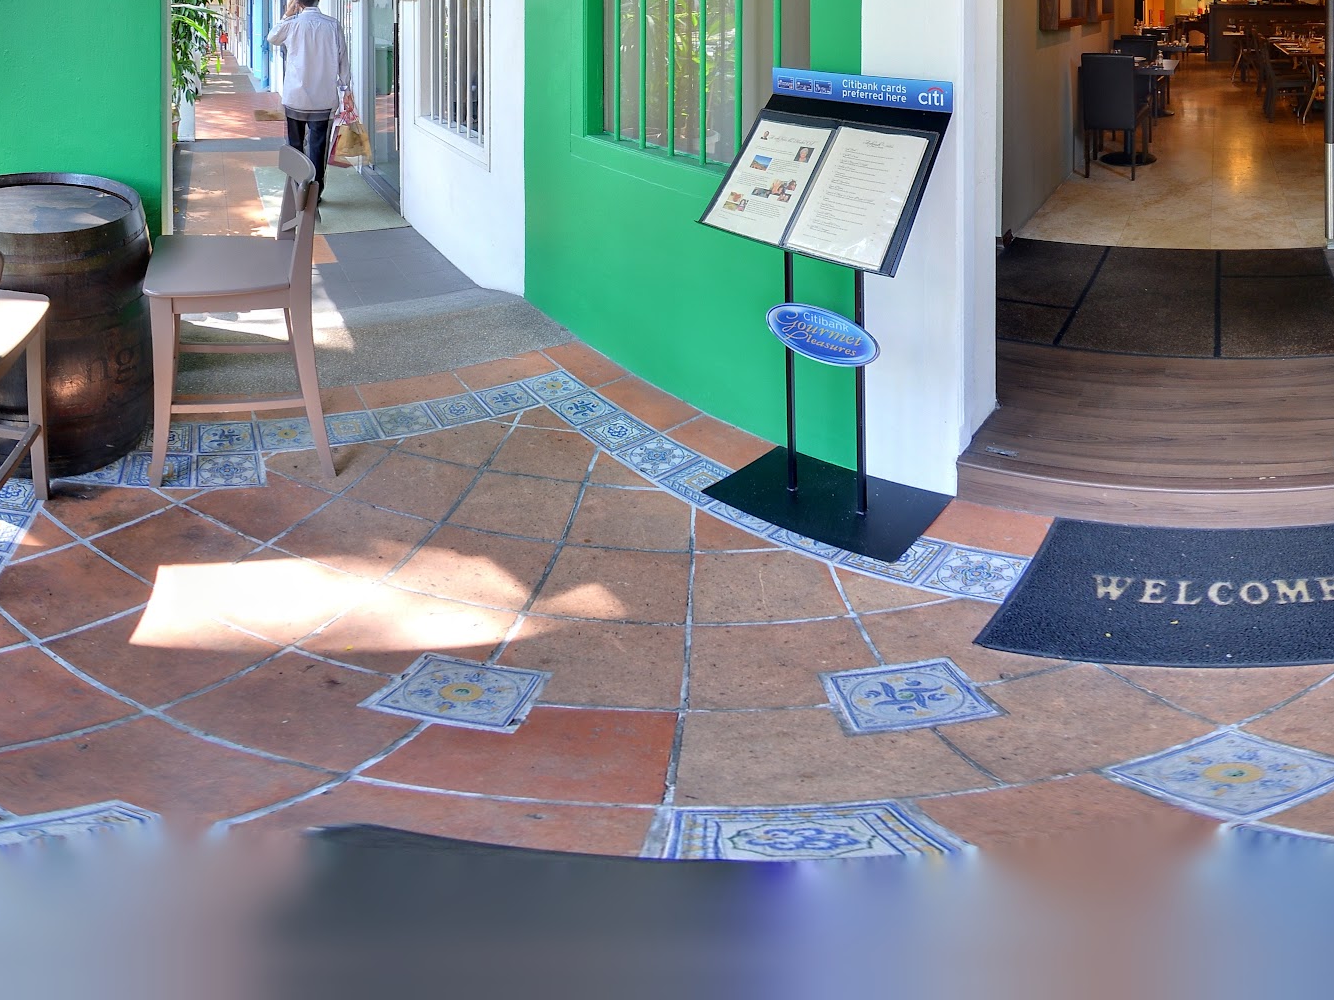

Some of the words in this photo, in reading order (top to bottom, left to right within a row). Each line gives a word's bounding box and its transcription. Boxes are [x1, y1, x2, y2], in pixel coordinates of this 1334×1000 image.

[842, 79, 878, 91] Citibank
[881, 83, 907, 93] cards
[842, 89, 883, 101] preferred
[886, 92, 907, 103] here
[918, 87, 945, 106] citi
[775, 309, 863, 347] Gourmet
[803, 312, 849, 332] Citibank
[784, 330, 857, 356] Pleasures
